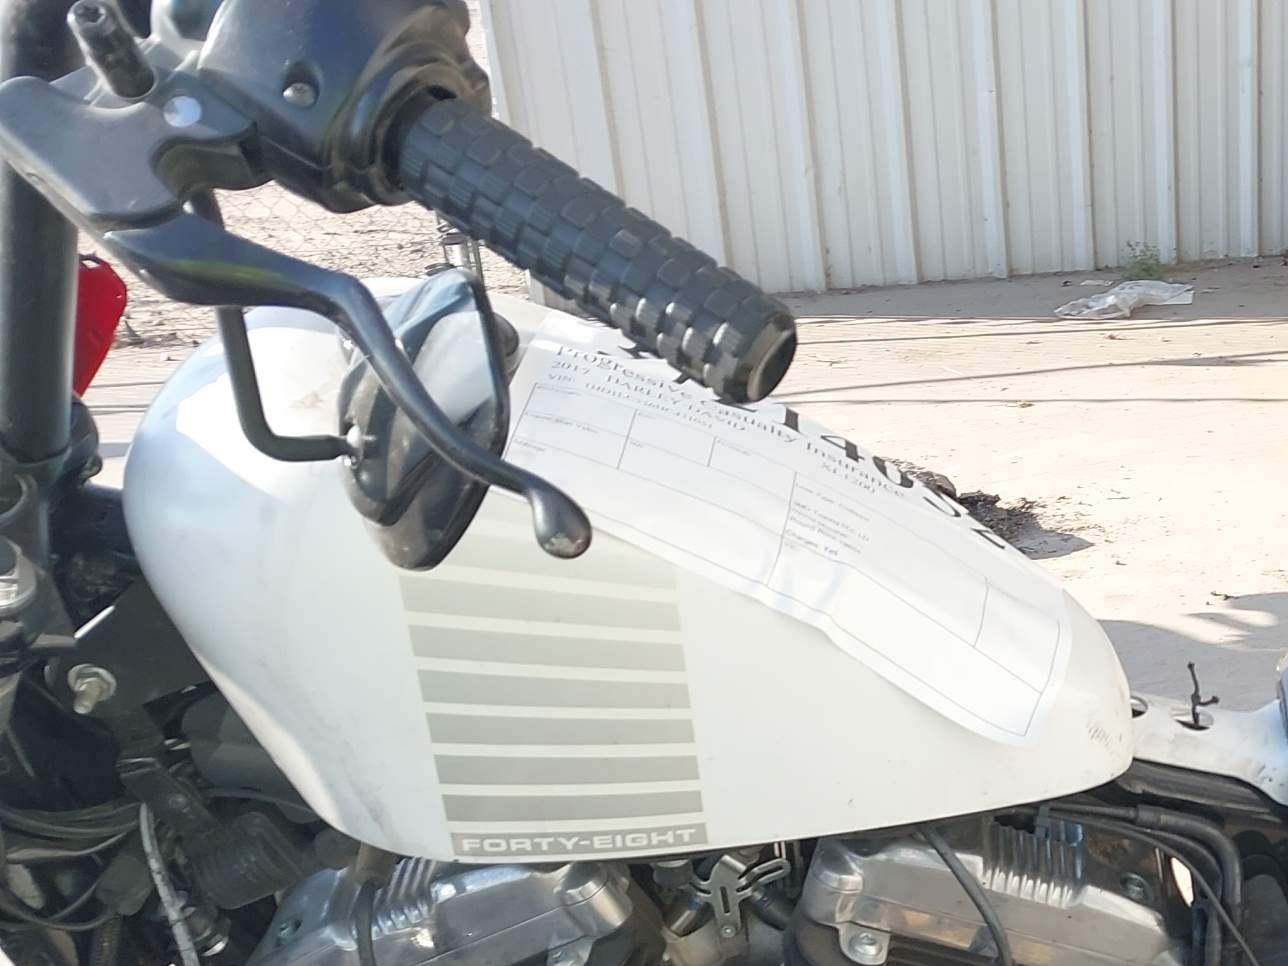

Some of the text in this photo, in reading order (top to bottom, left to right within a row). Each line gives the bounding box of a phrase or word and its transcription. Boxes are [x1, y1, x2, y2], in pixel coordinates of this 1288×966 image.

[550, 359, 591, 376] 2017
[556, 345, 693, 400] Progressive
[806, 441, 905, 498] Insurance
[461, 828, 697, 852] FORTY-EIGHT
